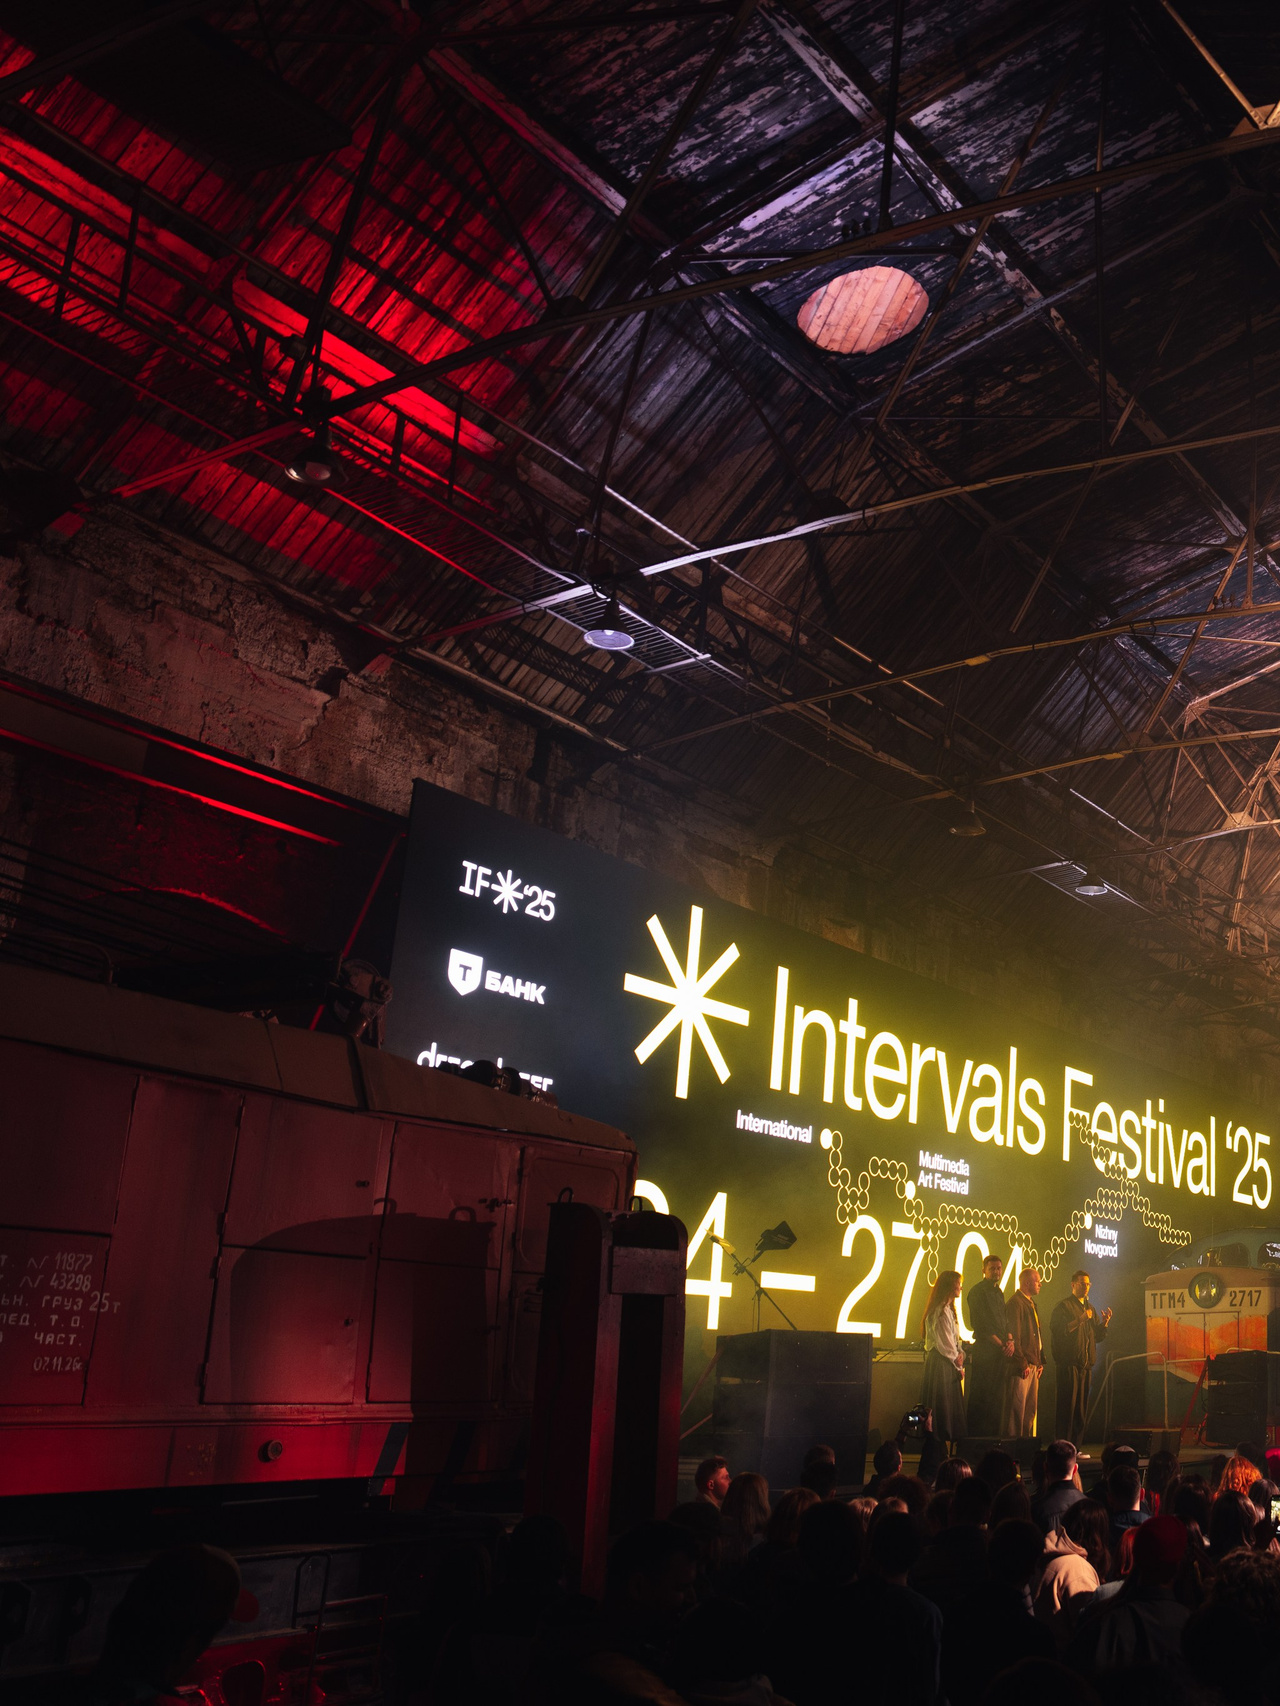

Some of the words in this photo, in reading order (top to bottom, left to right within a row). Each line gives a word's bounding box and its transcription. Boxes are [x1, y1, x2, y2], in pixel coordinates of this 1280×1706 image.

[484, 969, 547, 1005] БАНК
[769, 965, 1046, 1156] Intervals
[1062, 1065, 1216, 1197] Festival
[736, 1109, 813, 1144] International
[918, 1149, 970, 1177] Multimedia
[917, 1169, 933, 1189] Art
[934, 1172, 969, 1195] Festival
[1095, 1223, 1119, 1245] Nizhny
[1084, 1238, 1118, 1259] Novgorod
[50, 1272, 92, 1293] 43298
[42, 1294, 83, 1311] ГРУЗ
[1151, 1291, 1186, 1309] ТГМ4
[1229, 1289, 1262, 1307] 2717
